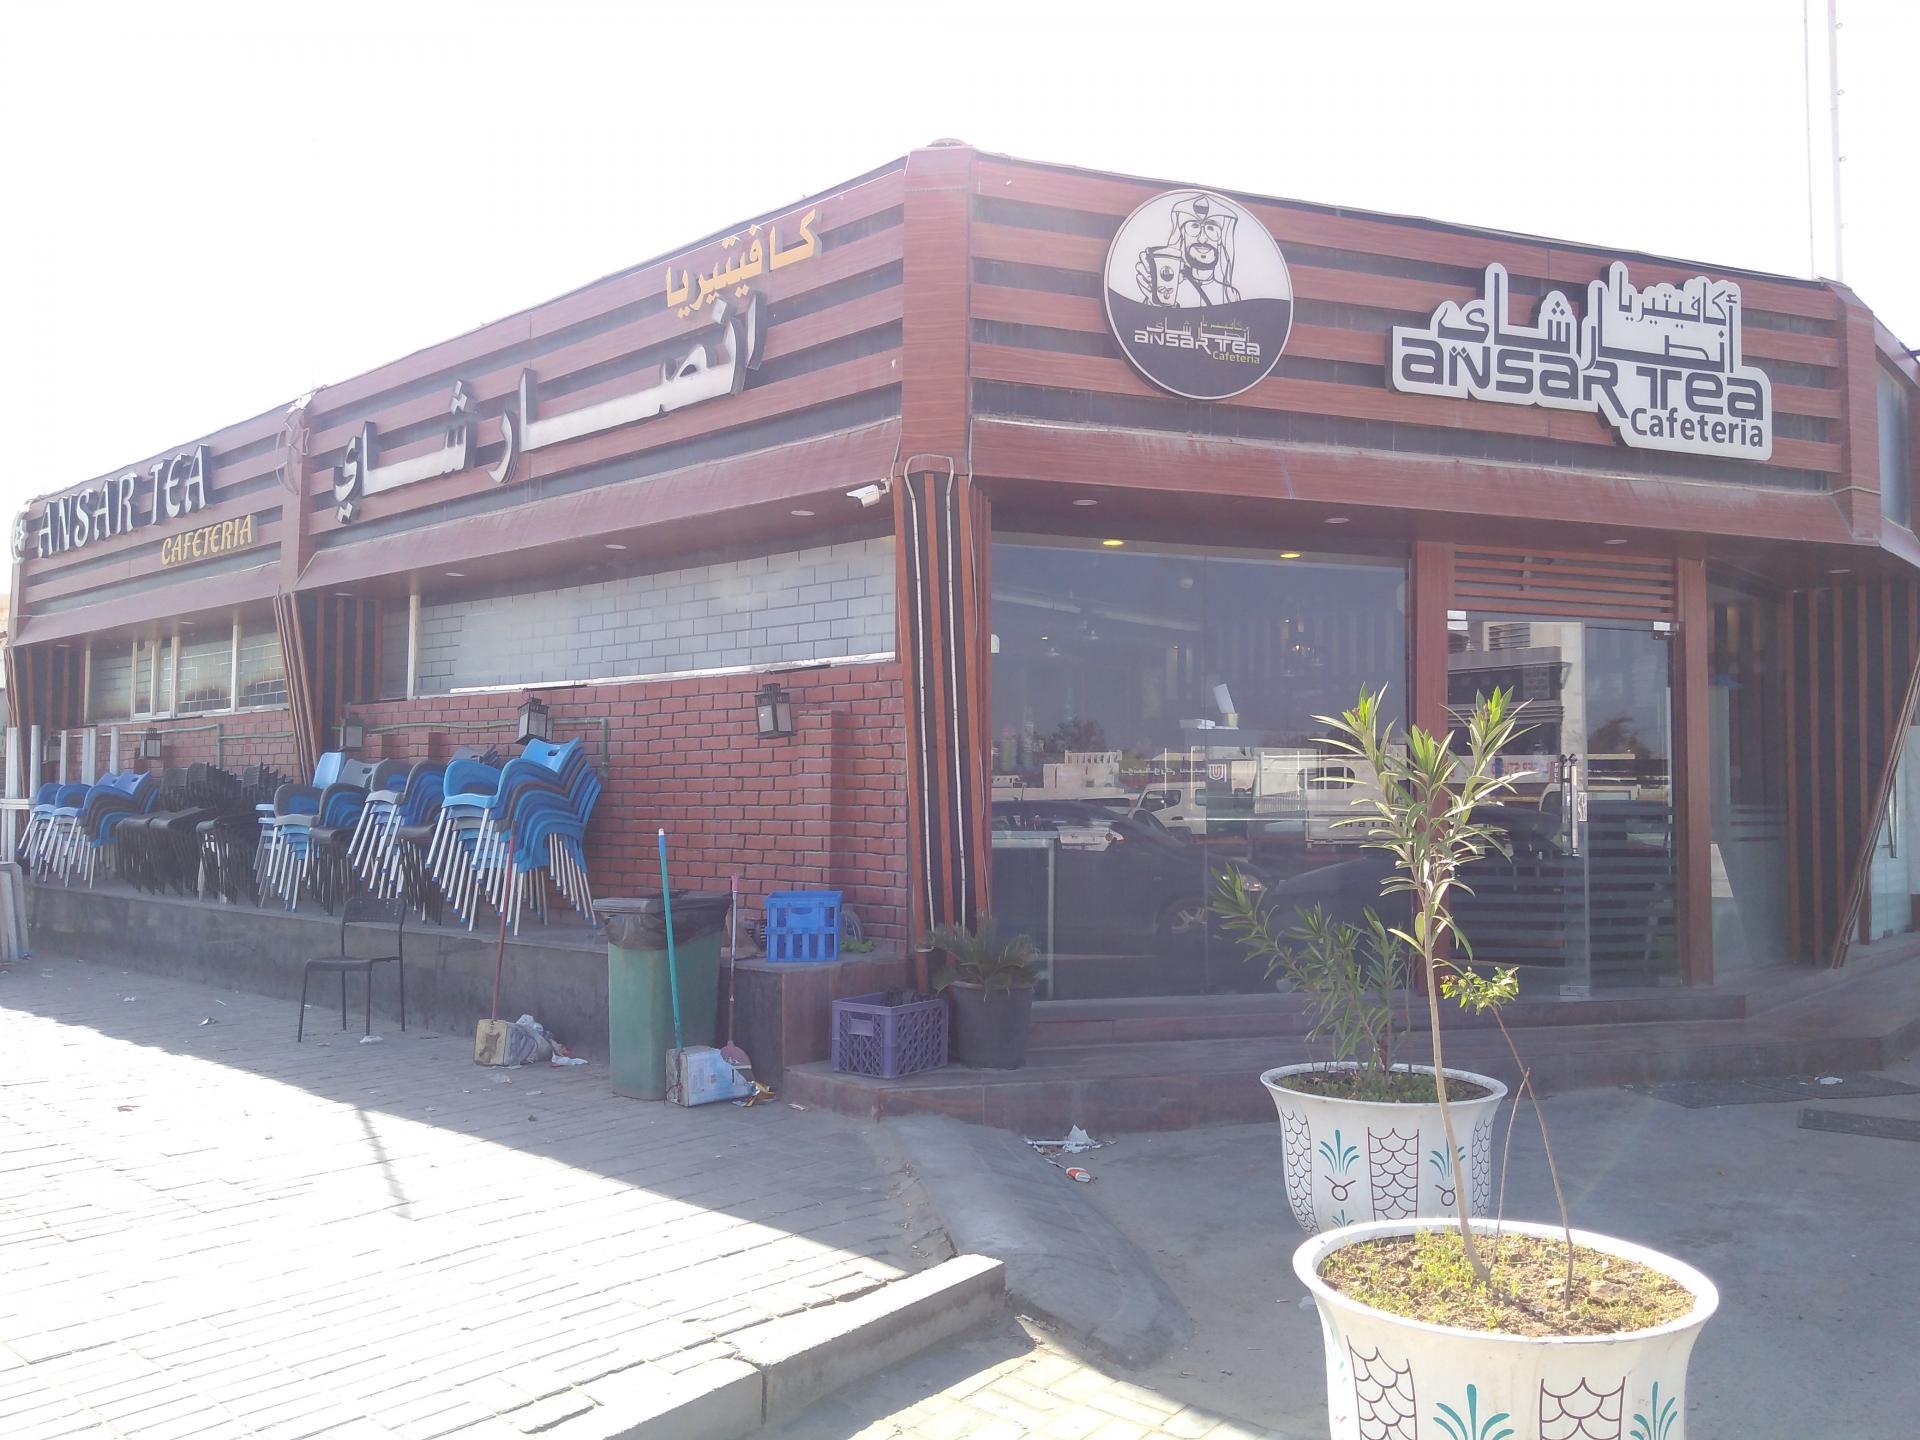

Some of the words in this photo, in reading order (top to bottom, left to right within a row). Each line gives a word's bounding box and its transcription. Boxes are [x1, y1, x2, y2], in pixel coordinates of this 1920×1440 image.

[665, 208, 819, 319] كافيتيريا
[1618, 271, 1727, 329] كافيتيريا
[1212, 350, 1260, 365] Cafeteria
[1636, 366, 1764, 421] Tea
[334, 379, 473, 525] شاي
[1630, 407, 1763, 448] Cafeteria
[38, 473, 137, 558] ANSAR
[150, 443, 209, 525] TEA
[161, 515, 257, 566] CAFETERIA
